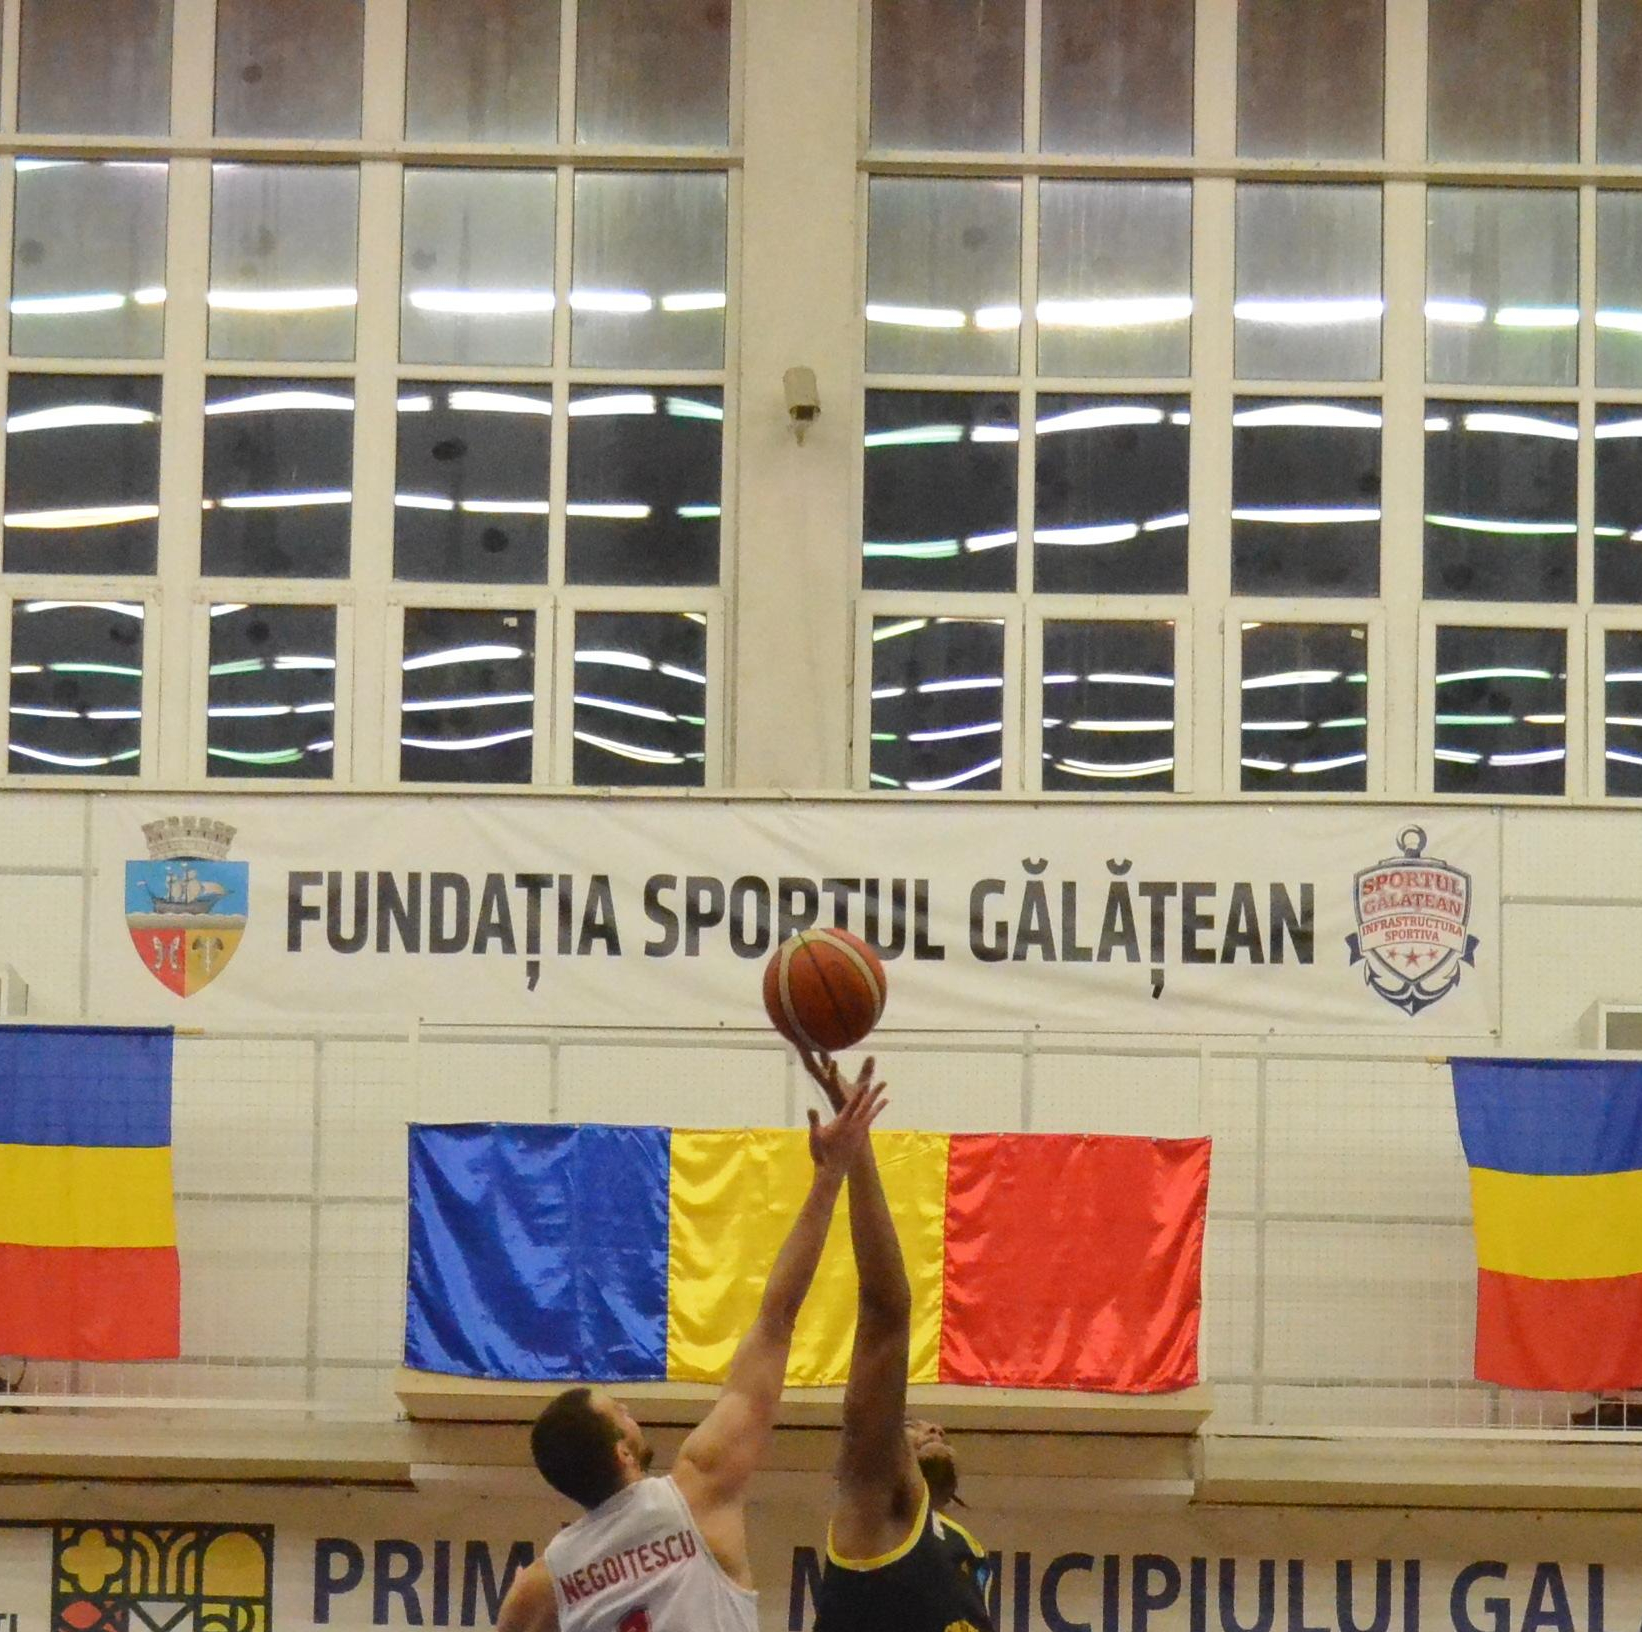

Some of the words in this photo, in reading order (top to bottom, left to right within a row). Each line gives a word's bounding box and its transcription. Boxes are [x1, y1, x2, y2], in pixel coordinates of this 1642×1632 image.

[1362, 871, 1463, 898] SPORTUL
[287, 870, 622, 992] FUNDAȚIA
[644, 875, 946, 961] SPORTUL
[968, 857, 1315, 1000] GĂLĂȚEAN
